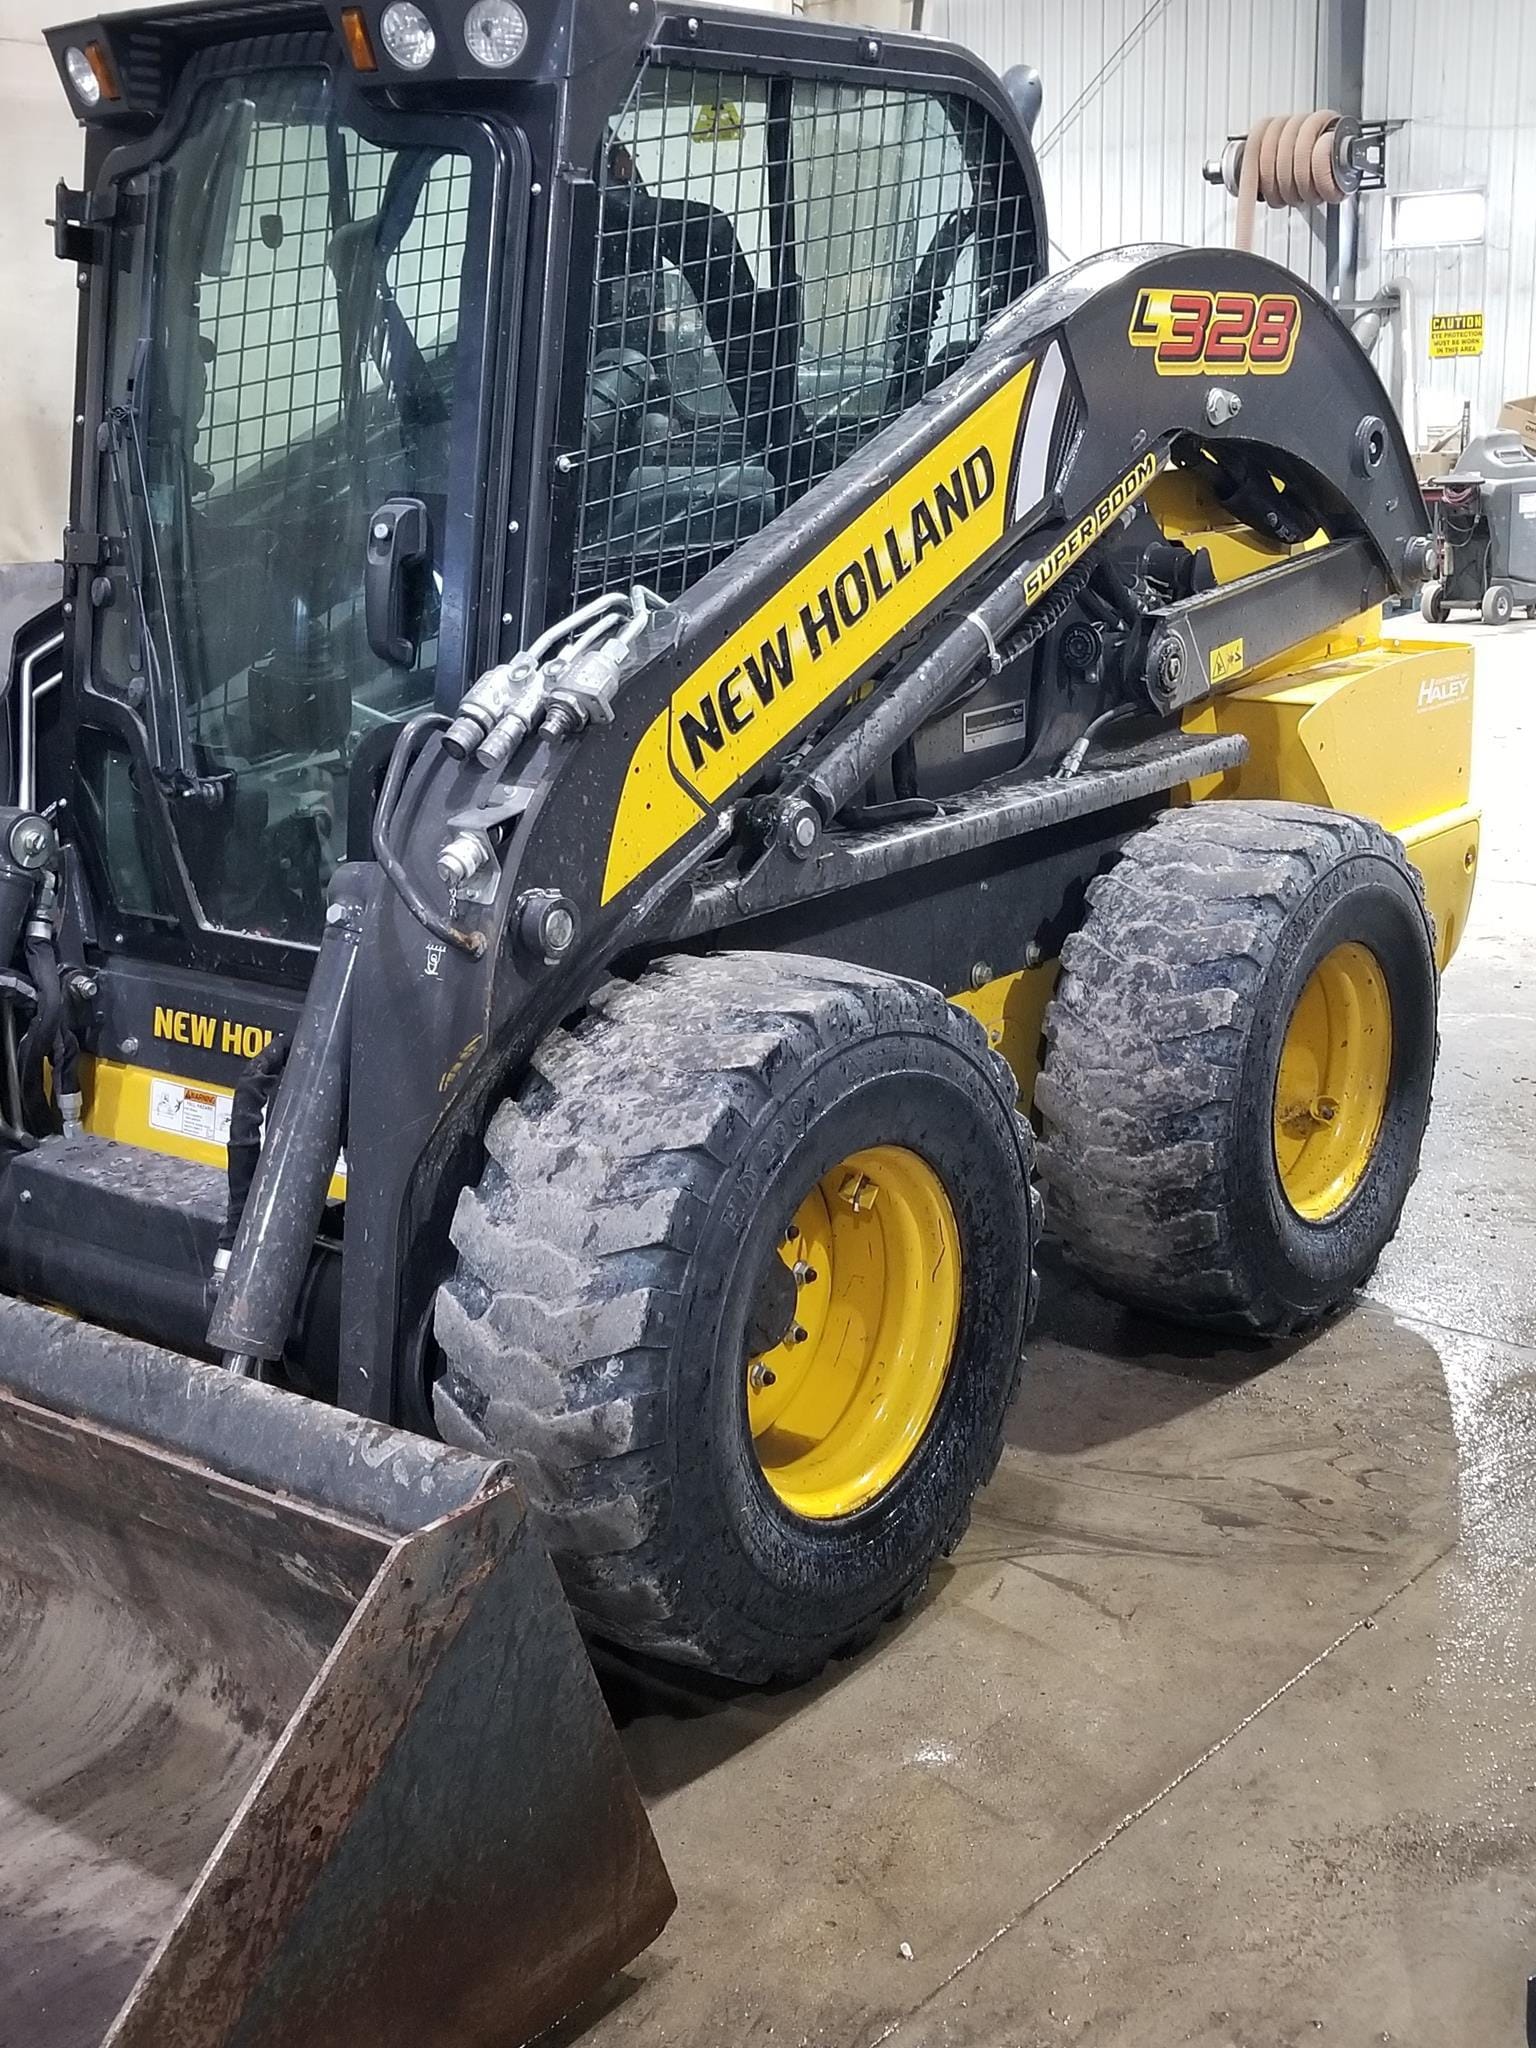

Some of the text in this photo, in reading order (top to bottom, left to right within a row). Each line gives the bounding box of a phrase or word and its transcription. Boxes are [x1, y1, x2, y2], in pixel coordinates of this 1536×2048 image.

[1131, 291, 1300, 370] L328
[1432, 316, 1482, 330] CAUTION
[1443, 330, 1483, 338] PROTECTION
[1025, 454, 1155, 604] SUPER BOOM
[678, 445, 996, 772] NEW HOLLAND
[1417, 678, 1470, 706] HALEY
[153, 1006, 217, 1049] NEW
